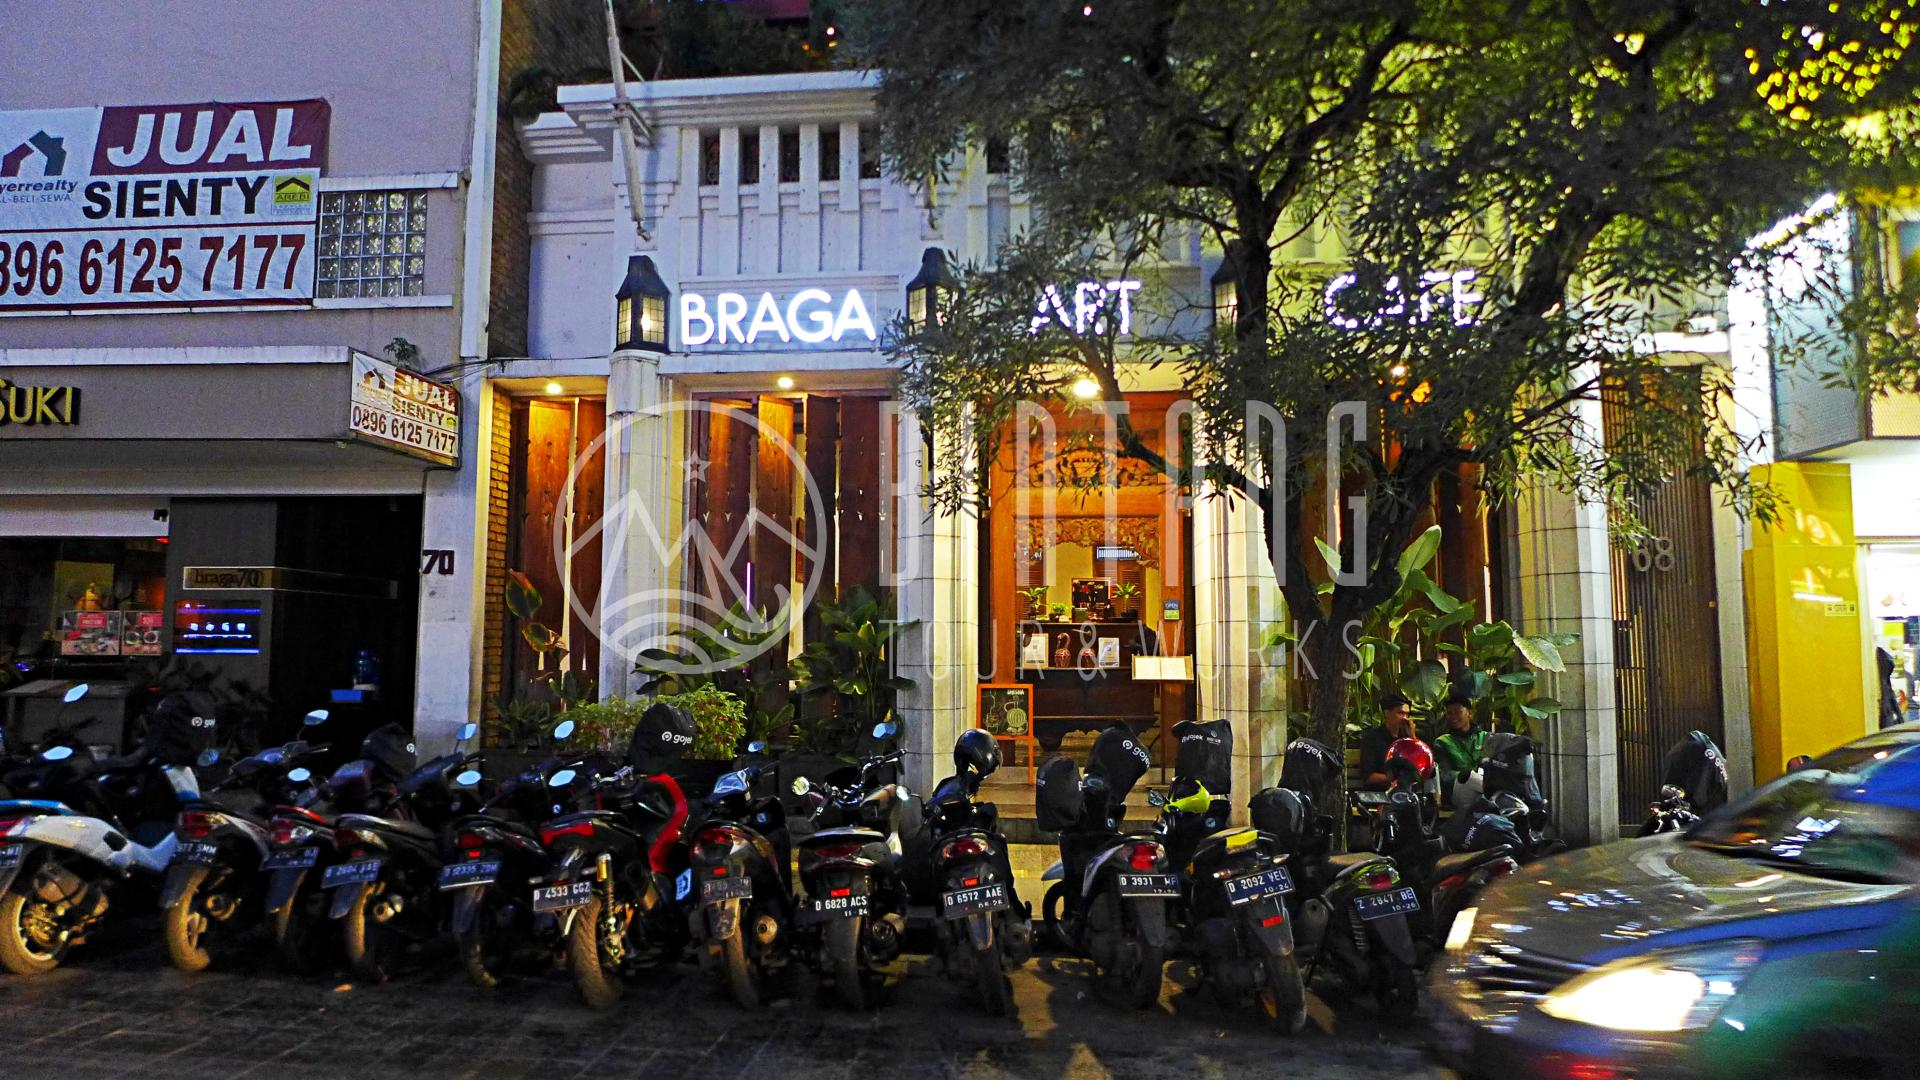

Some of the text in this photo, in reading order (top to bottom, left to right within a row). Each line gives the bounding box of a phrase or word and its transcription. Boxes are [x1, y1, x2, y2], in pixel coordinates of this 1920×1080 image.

[107, 107, 313, 168] JUAL
[82, 175, 270, 220] SIENTY
[80, 237, 183, 296] 6125
[200, 233, 306, 292] 7177
[680, 288, 877, 346] BRAGA
[1029, 279, 1141, 335] ART
[398, 374, 456, 413] JUAL
[391, 396, 445, 426] SIENTY
[352, 405, 456, 454] 0896 6125 7177
[422, 549, 455, 575] 70
[1632, 536, 1675, 571] 68
[1297, 742, 1323, 760] gojek
[545, 886, 568, 899] 4533
[947, 886, 1002, 906] D 6572 AAE
[1120, 877, 1127, 886] D
[1131, 876, 1153, 886] 3931
[1228, 882, 1236, 893] D
[1240, 875, 1265, 890] 2092
[815, 895, 867, 911] D 6828 ACS
[1356, 899, 1365, 909] Z
[1400, 889, 1414, 901] BE
